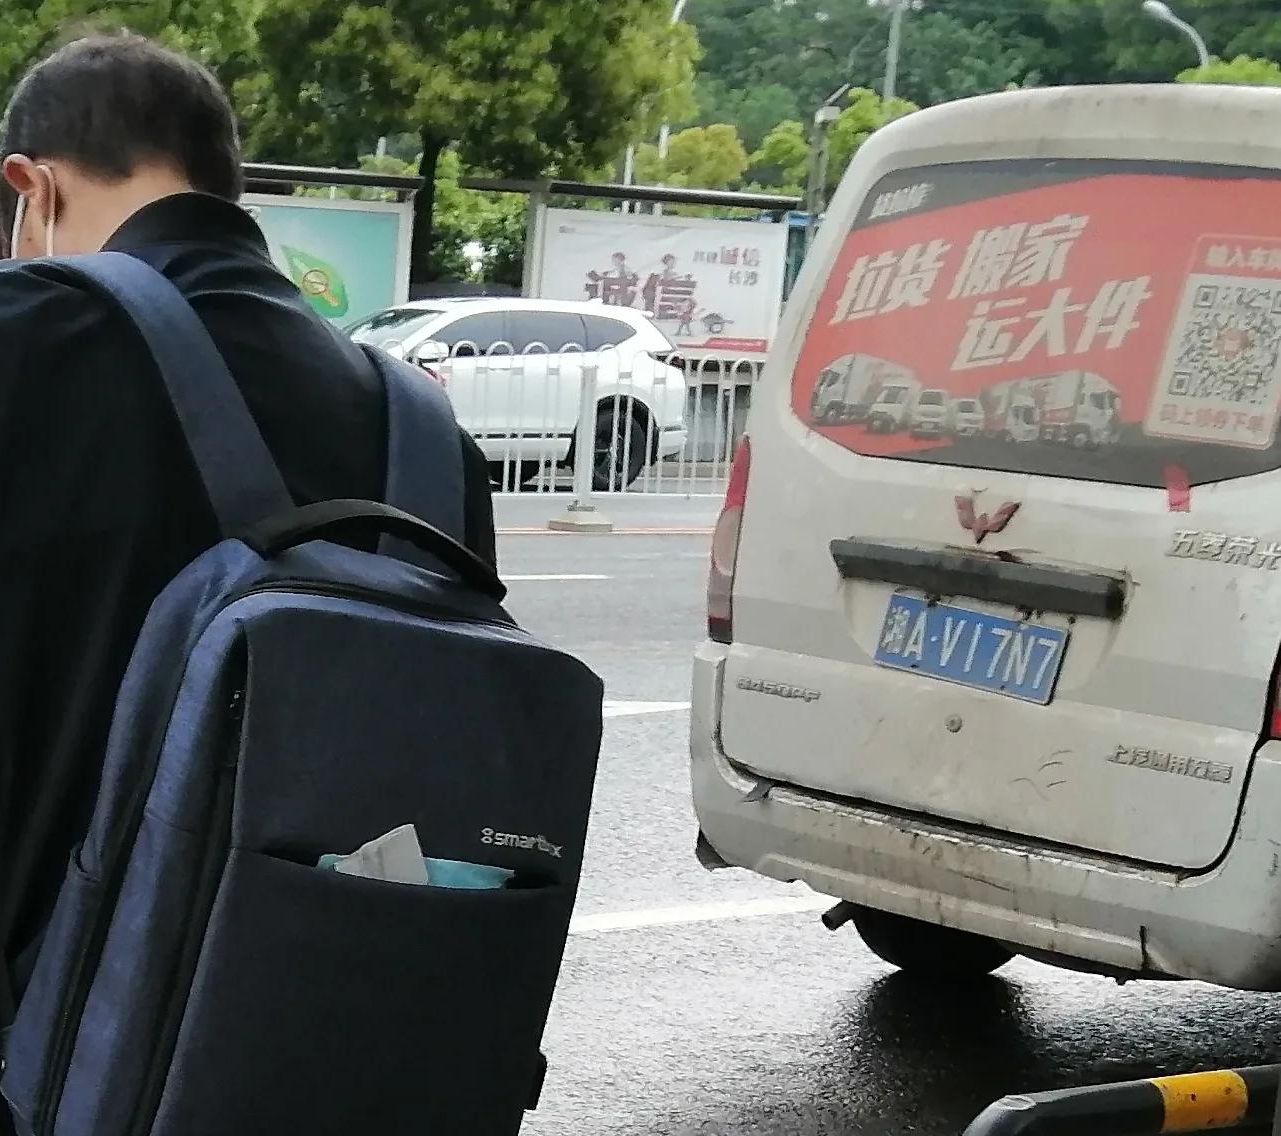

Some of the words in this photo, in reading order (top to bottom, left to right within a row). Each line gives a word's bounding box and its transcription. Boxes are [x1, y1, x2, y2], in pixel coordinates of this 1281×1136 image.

[829, 238, 951, 326] 拉货
[948, 213, 1090, 300] 搬家
[950, 275, 1152, 371] 运大件
[1168, 528, 1281, 571] 五菱荣光
